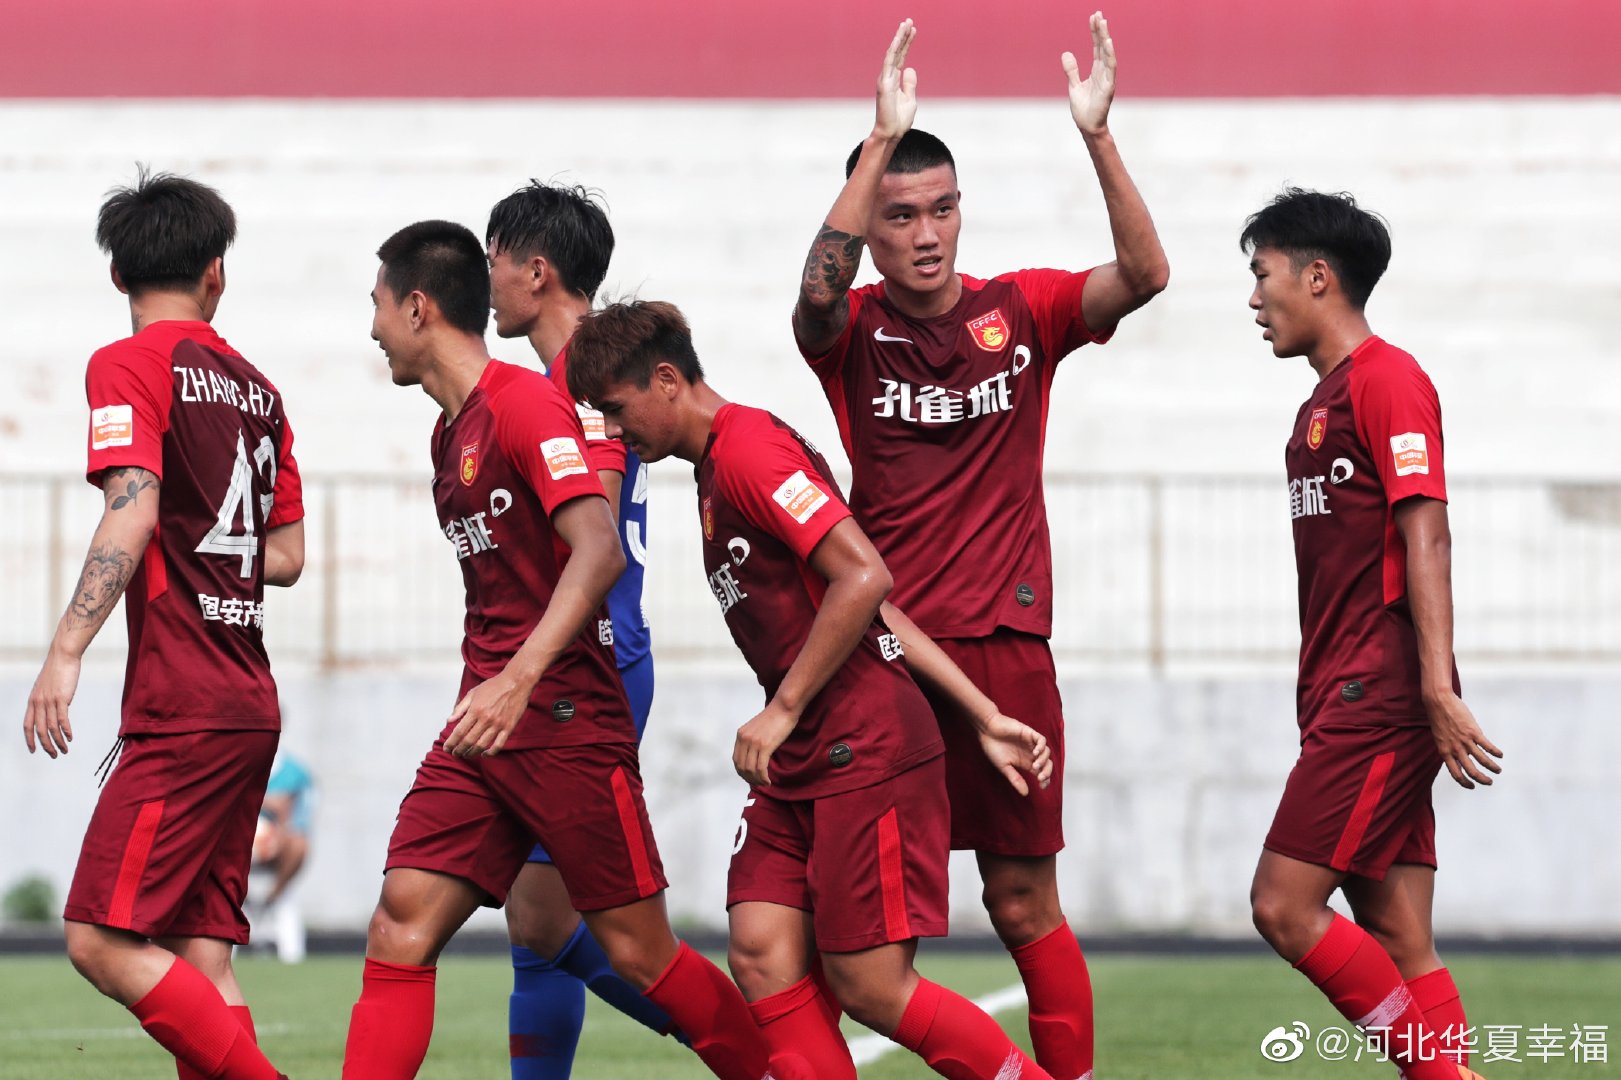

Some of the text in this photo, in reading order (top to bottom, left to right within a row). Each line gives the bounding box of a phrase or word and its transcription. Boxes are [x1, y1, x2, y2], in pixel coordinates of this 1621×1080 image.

[972, 313, 998, 329] CFFC
[173, 366, 248, 412] ZHANG
[872, 370, 1014, 424] 孔雀城
